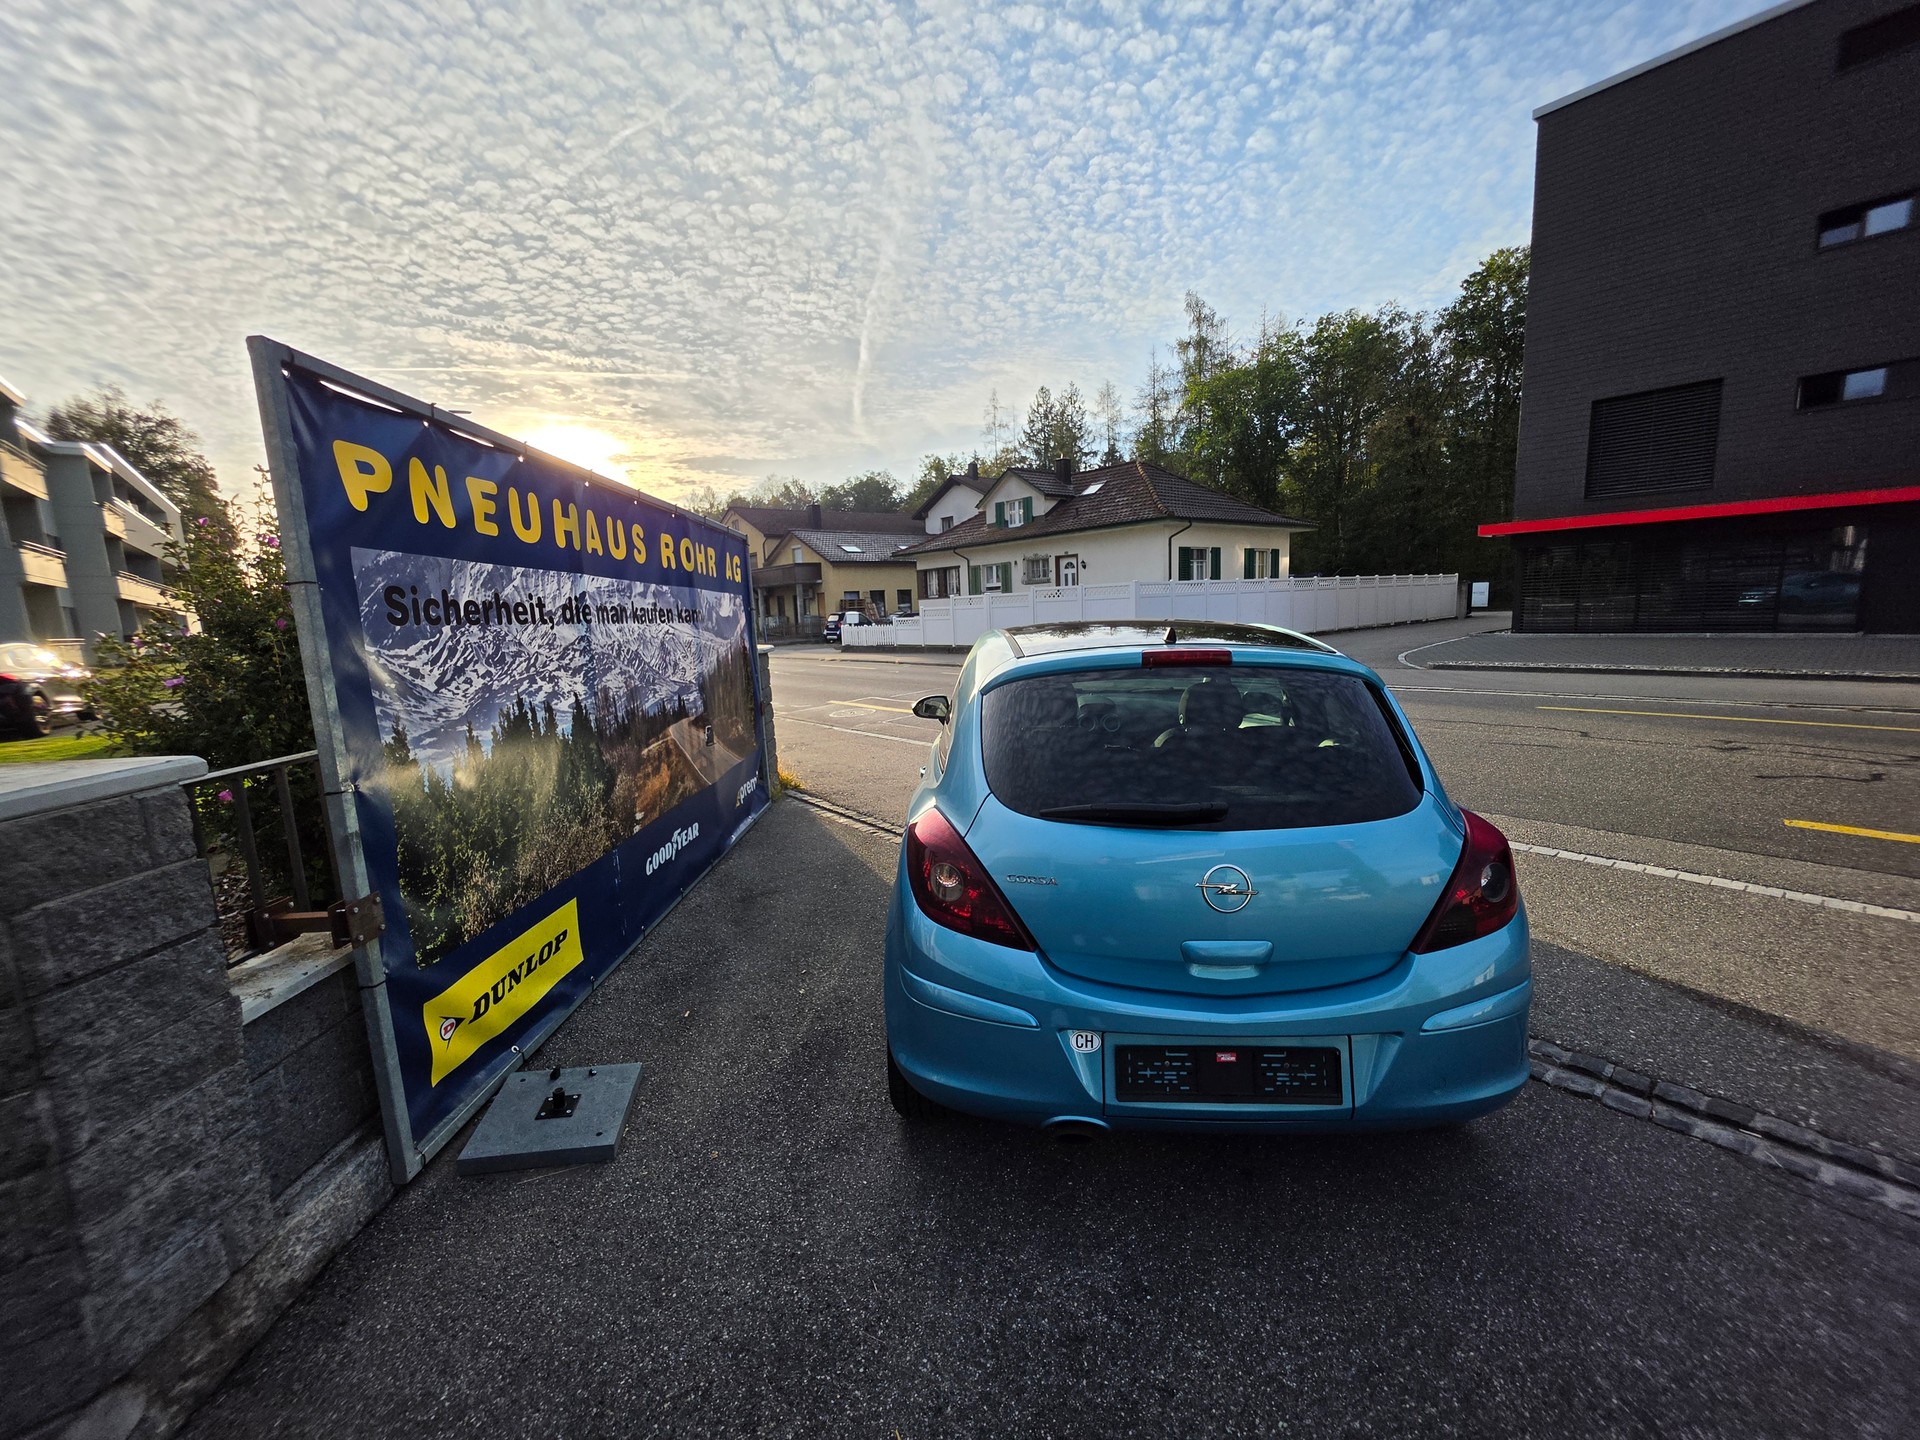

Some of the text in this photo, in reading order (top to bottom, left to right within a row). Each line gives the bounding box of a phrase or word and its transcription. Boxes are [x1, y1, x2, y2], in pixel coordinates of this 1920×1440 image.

[332, 439, 742, 583] PNEUHAUS ROHR AG
[383, 585, 555, 630] Sicherheit,
[562, 594, 592, 625] die
[596, 603, 628, 625] man
[631, 601, 674, 625] kaufen
[645, 822, 699, 876] GOODYEAR
[1006, 873, 1058, 886] CORSA
[467, 929, 568, 1025] DUNLOP
[1075, 1033, 1094, 1049] CH
